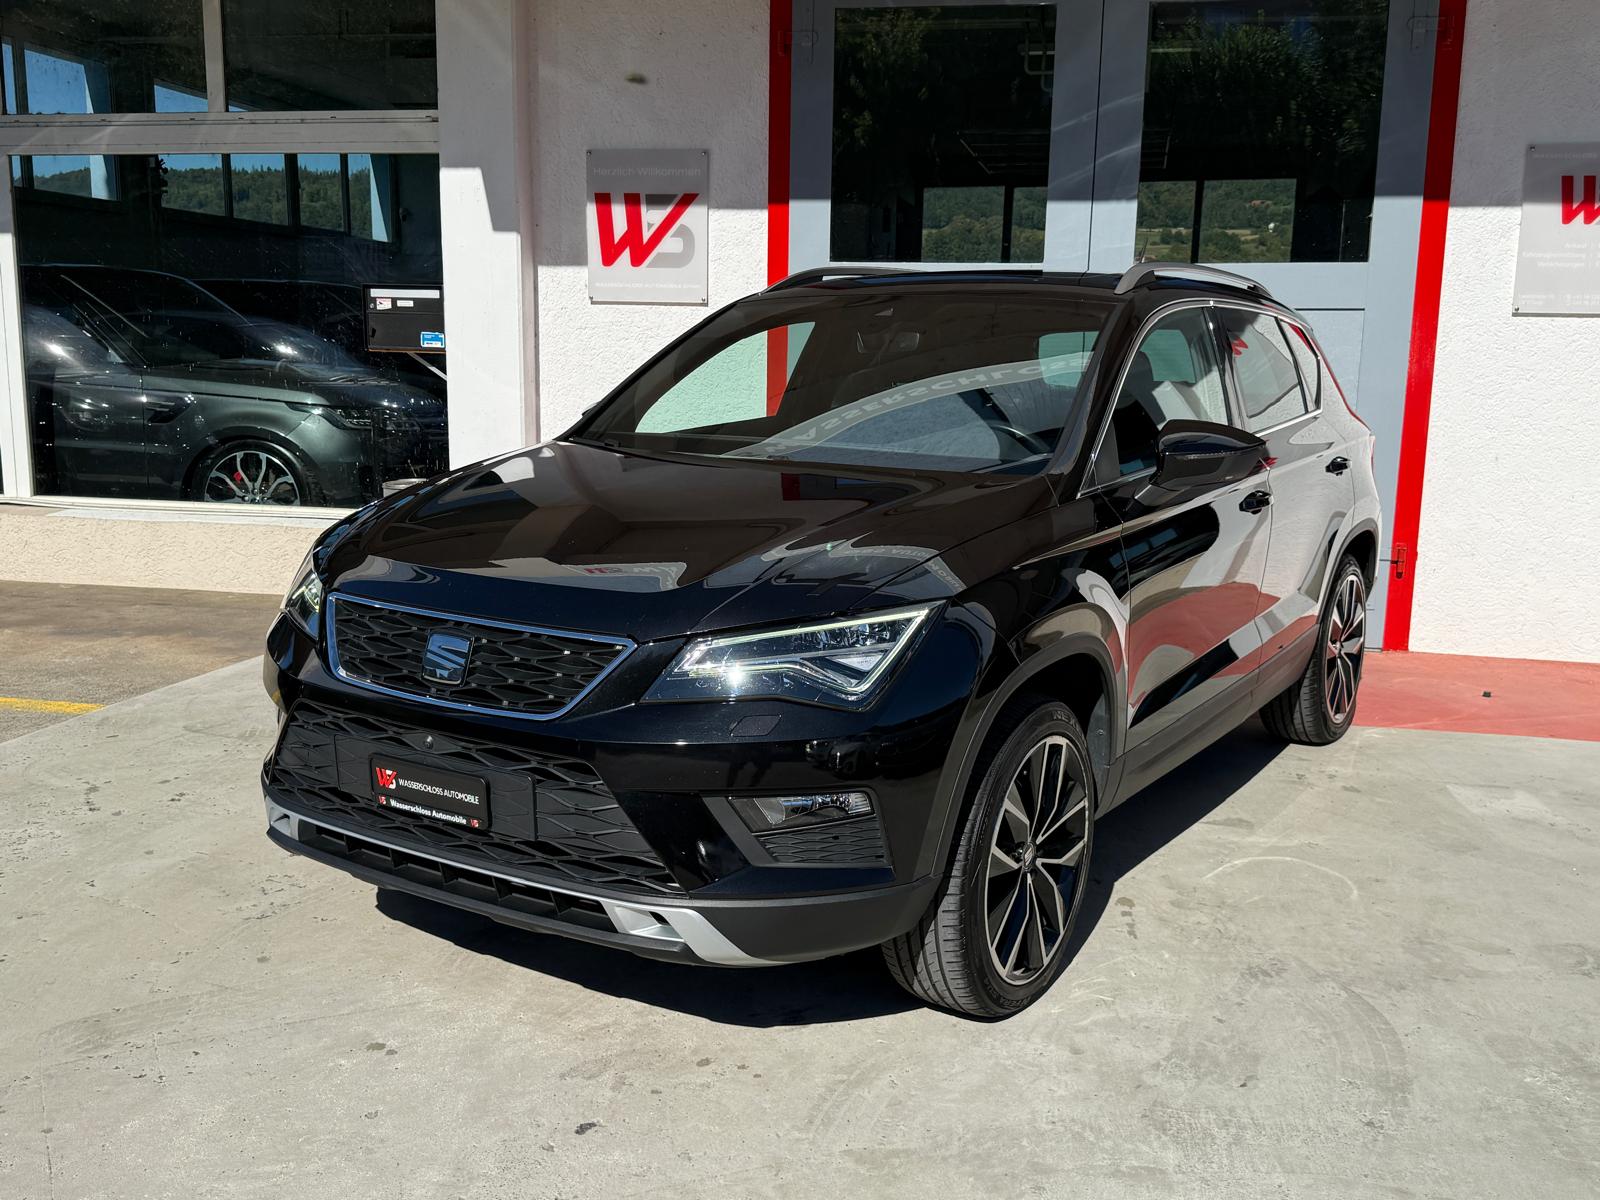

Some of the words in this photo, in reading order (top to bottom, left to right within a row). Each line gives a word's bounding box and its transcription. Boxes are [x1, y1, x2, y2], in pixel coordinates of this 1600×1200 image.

[398, 778, 444, 796] WASSERSCHLOSS
[443, 788, 480, 805] AUTOMOBILE
[390, 798, 431, 816] Wasserschloss
[431, 810, 467, 825] Automobile
